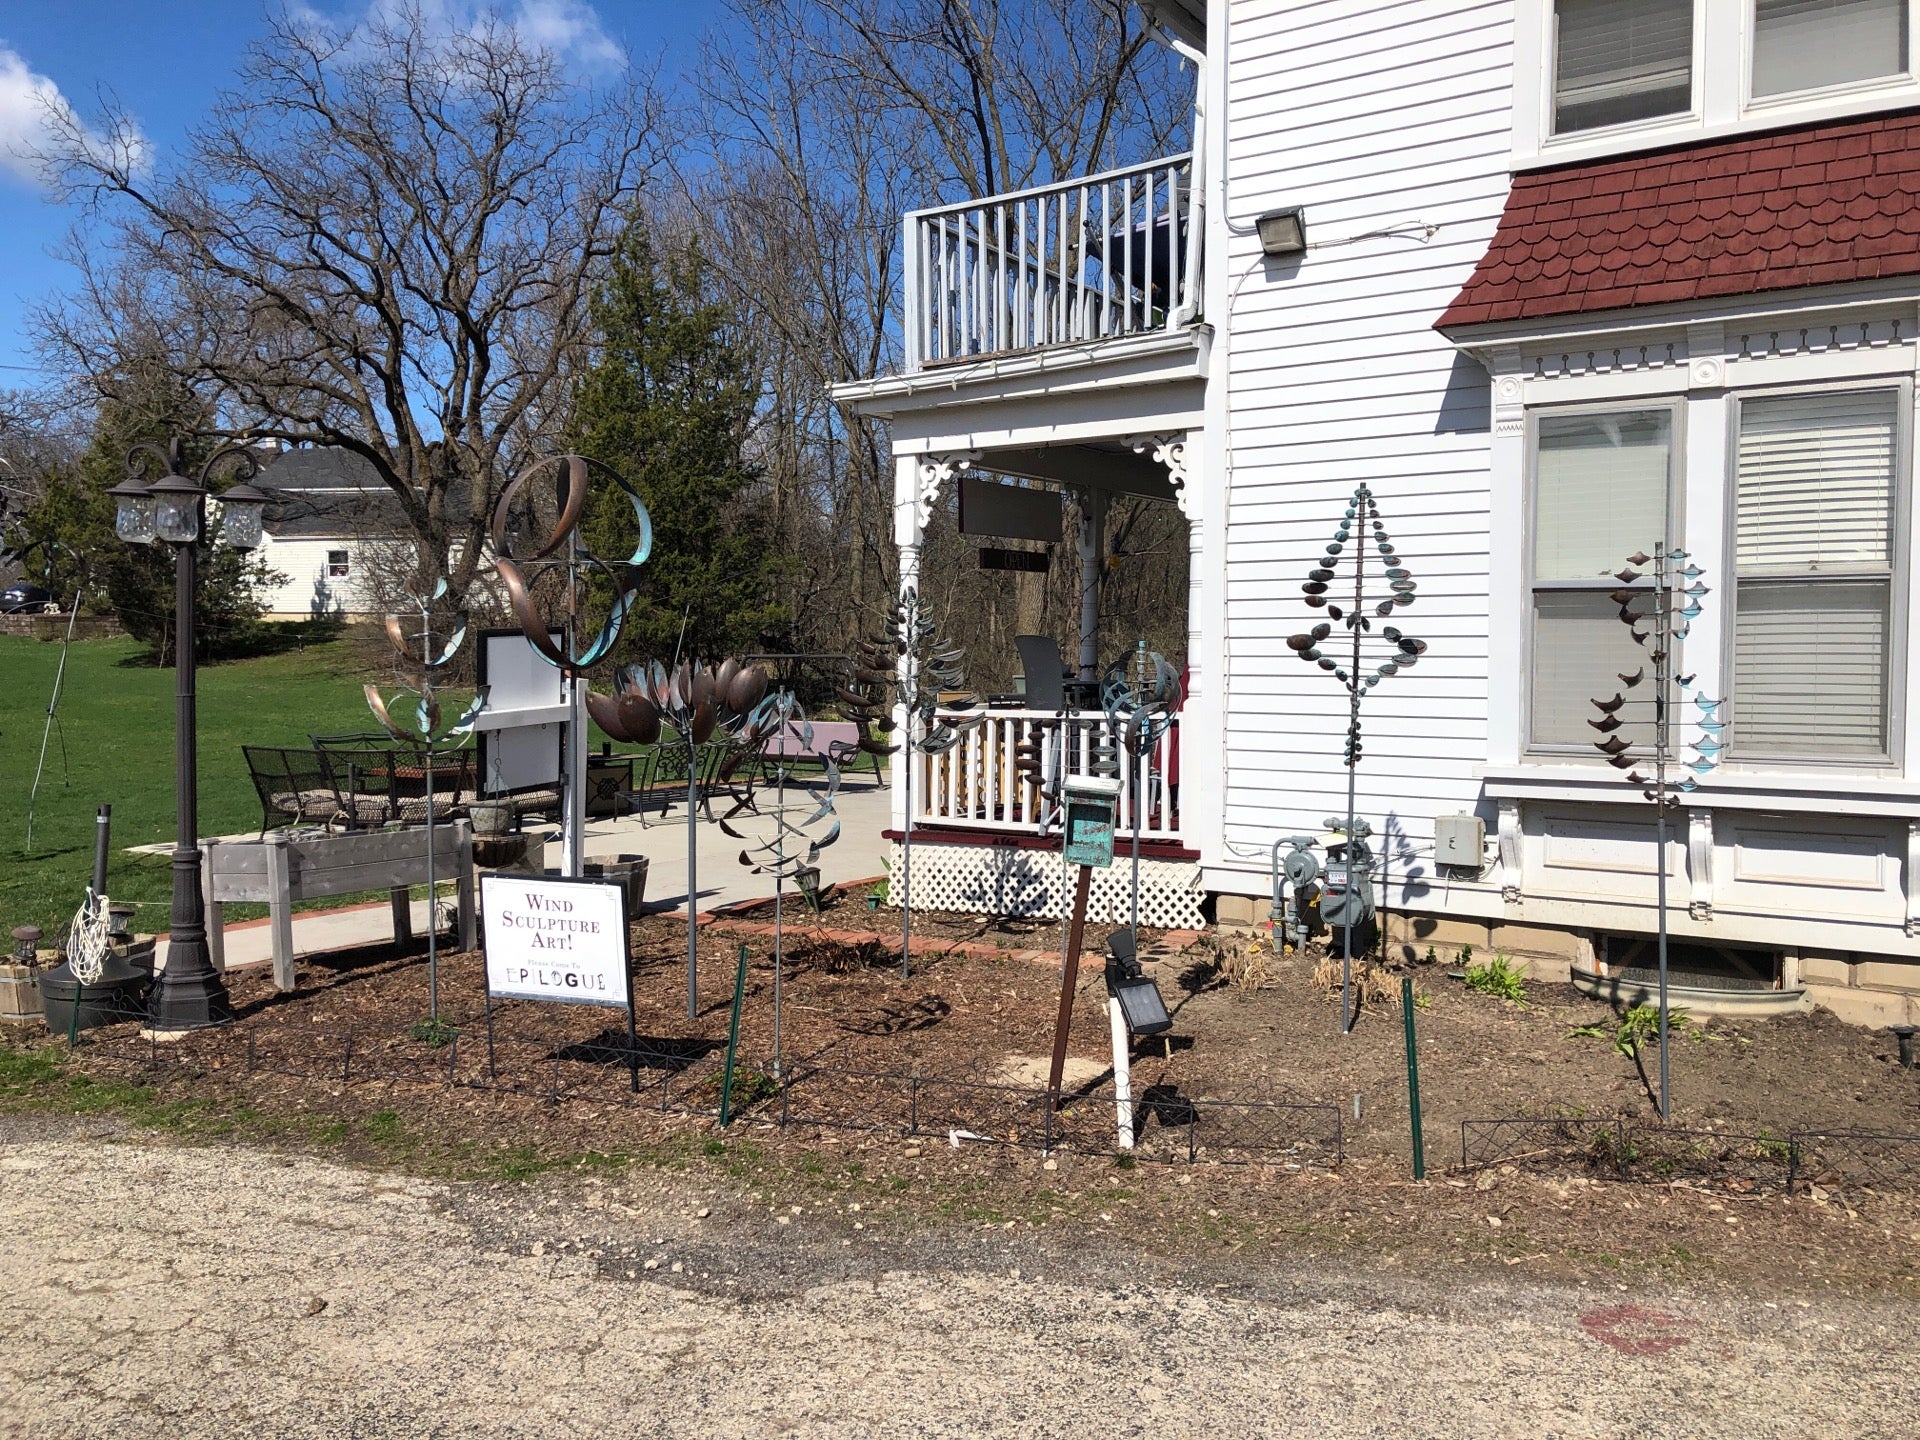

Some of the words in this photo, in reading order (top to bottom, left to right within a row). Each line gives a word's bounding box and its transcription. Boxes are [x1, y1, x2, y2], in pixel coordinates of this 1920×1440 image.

[525, 893, 573, 912] WIND
[502, 910, 600, 933] SCULPTURE
[531, 931, 572, 950] ART!
[506, 967, 605, 990] EPILOGUE
